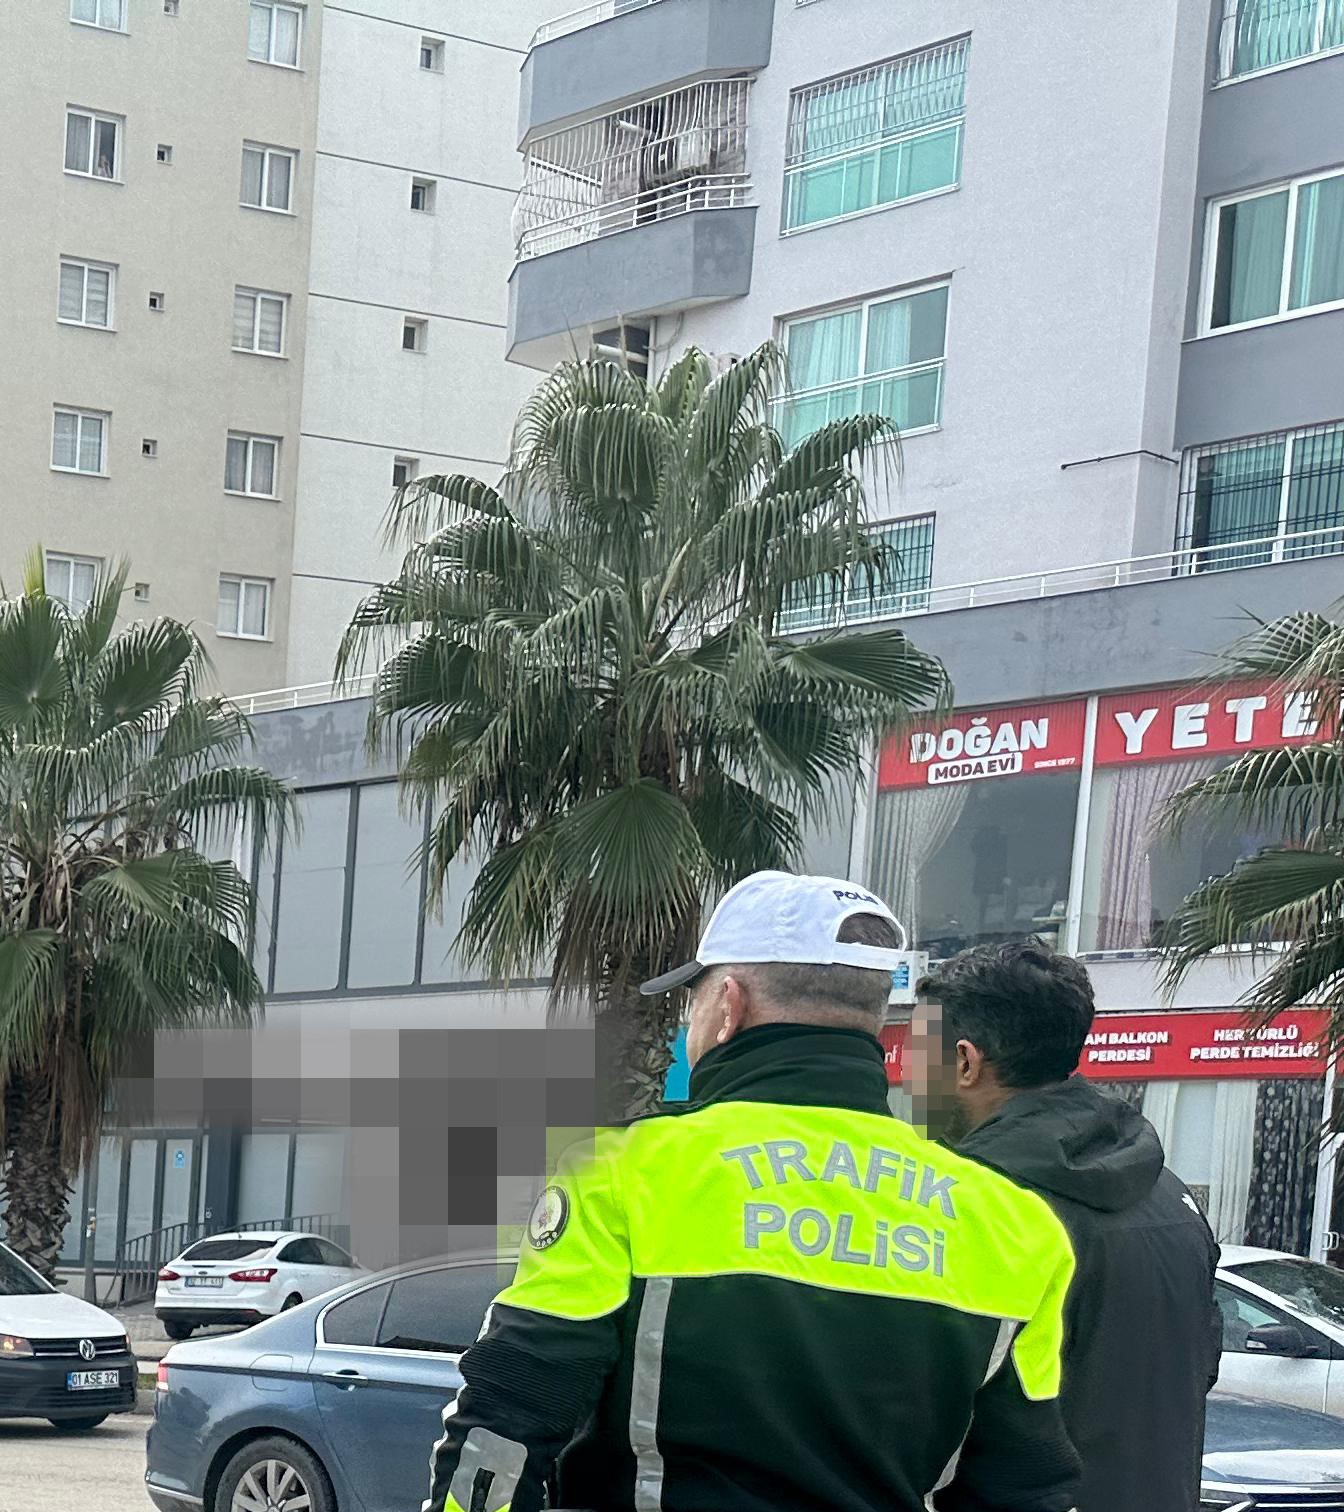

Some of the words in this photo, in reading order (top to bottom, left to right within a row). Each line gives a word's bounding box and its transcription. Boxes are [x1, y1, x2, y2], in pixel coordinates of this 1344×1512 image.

[909, 717, 1049, 764] DOĞAN
[934, 761, 984, 781] MODA
[987, 756, 1016, 774] EVİ
[1084, 1032, 1107, 1046] AM
[1111, 1031, 1169, 1045] BALKON
[1246, 1024, 1299, 1041] ÜRLÜ
[1088, 1046, 1151, 1062] PERDESİ
[1189, 1047, 1240, 1060] PERDE
[720, 1140, 959, 1220] TRAFİK
[744, 1202, 945, 1278] POLİSİ
